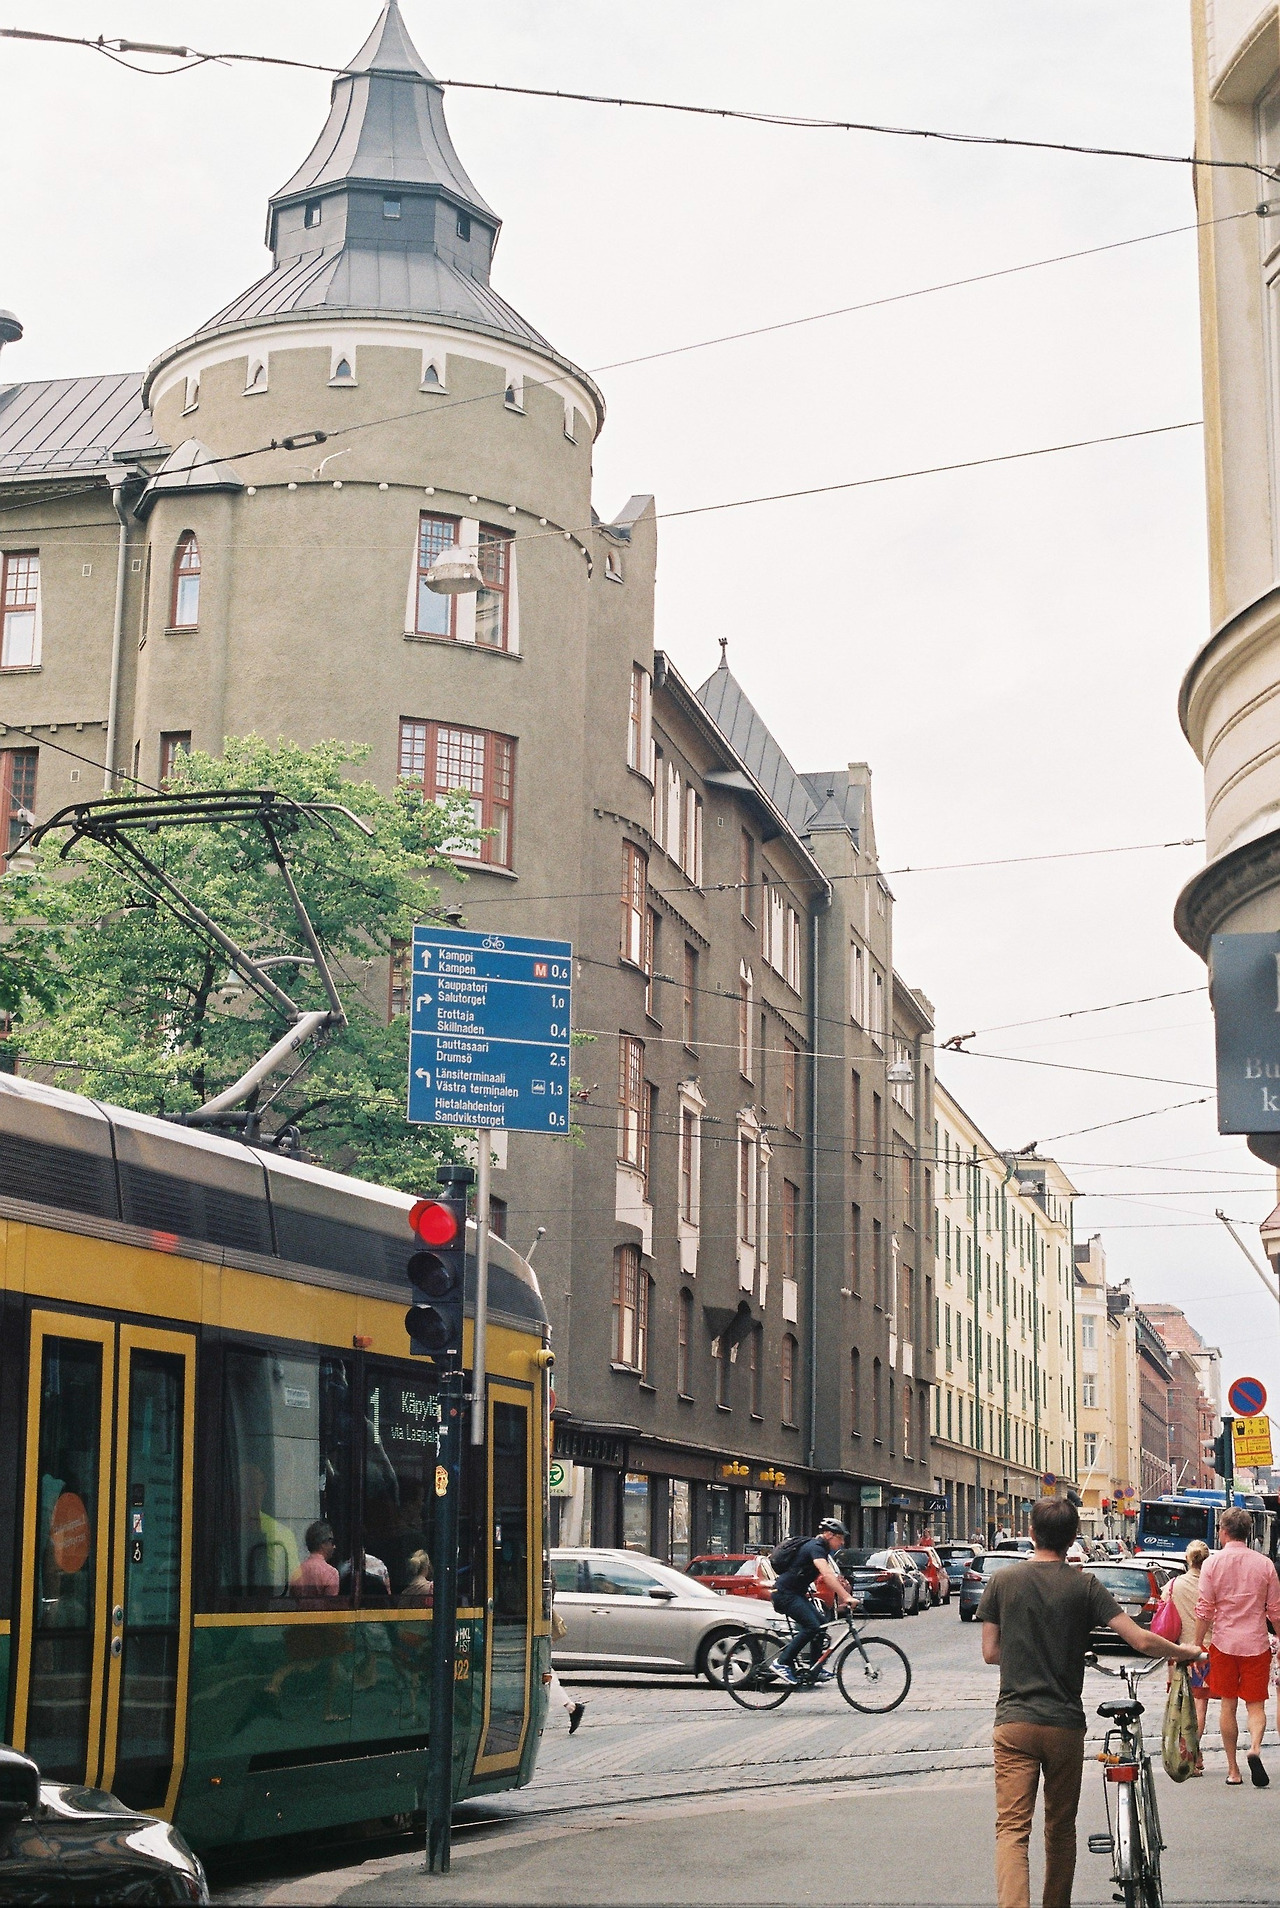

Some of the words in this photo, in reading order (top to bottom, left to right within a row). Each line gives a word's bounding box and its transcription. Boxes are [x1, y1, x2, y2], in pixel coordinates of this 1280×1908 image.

[438, 949, 474, 963] Kamppi
[438, 962, 476, 975] Kampen
[534, 965, 546, 977] M
[551, 965, 568, 979] 0,6
[438, 979, 488, 993] Kauppatori
[438, 992, 486, 1006] Salutorget
[551, 995, 565, 1009] 1,0
[437, 1008, 475, 1021] Erottaja
[437, 1021, 485, 1035] Skillnaden
[550, 1024, 567, 1038] 0,4
[436, 1038, 489, 1052] Lauttasaari
[436, 1051, 472, 1064] Drumsö
[550, 1053, 566, 1067] 2,5
[436, 1068, 506, 1083] Länsiterminaali
[436, 1080, 467, 1093] Västra
[470, 1084, 519, 1098] terminalen
[550, 1082, 563, 1096] 1,3
[435, 1098, 505, 1113] Hietalahdentori
[435, 1111, 505, 1126] Sandvikstorget
[549, 1112, 565, 1126] 0,5
[370, 1387, 379, 1444] 1
[722, 1460, 750, 1477] pic
[459, 1627, 471, 1640] HKL
[459, 1640, 471, 1652] HST
